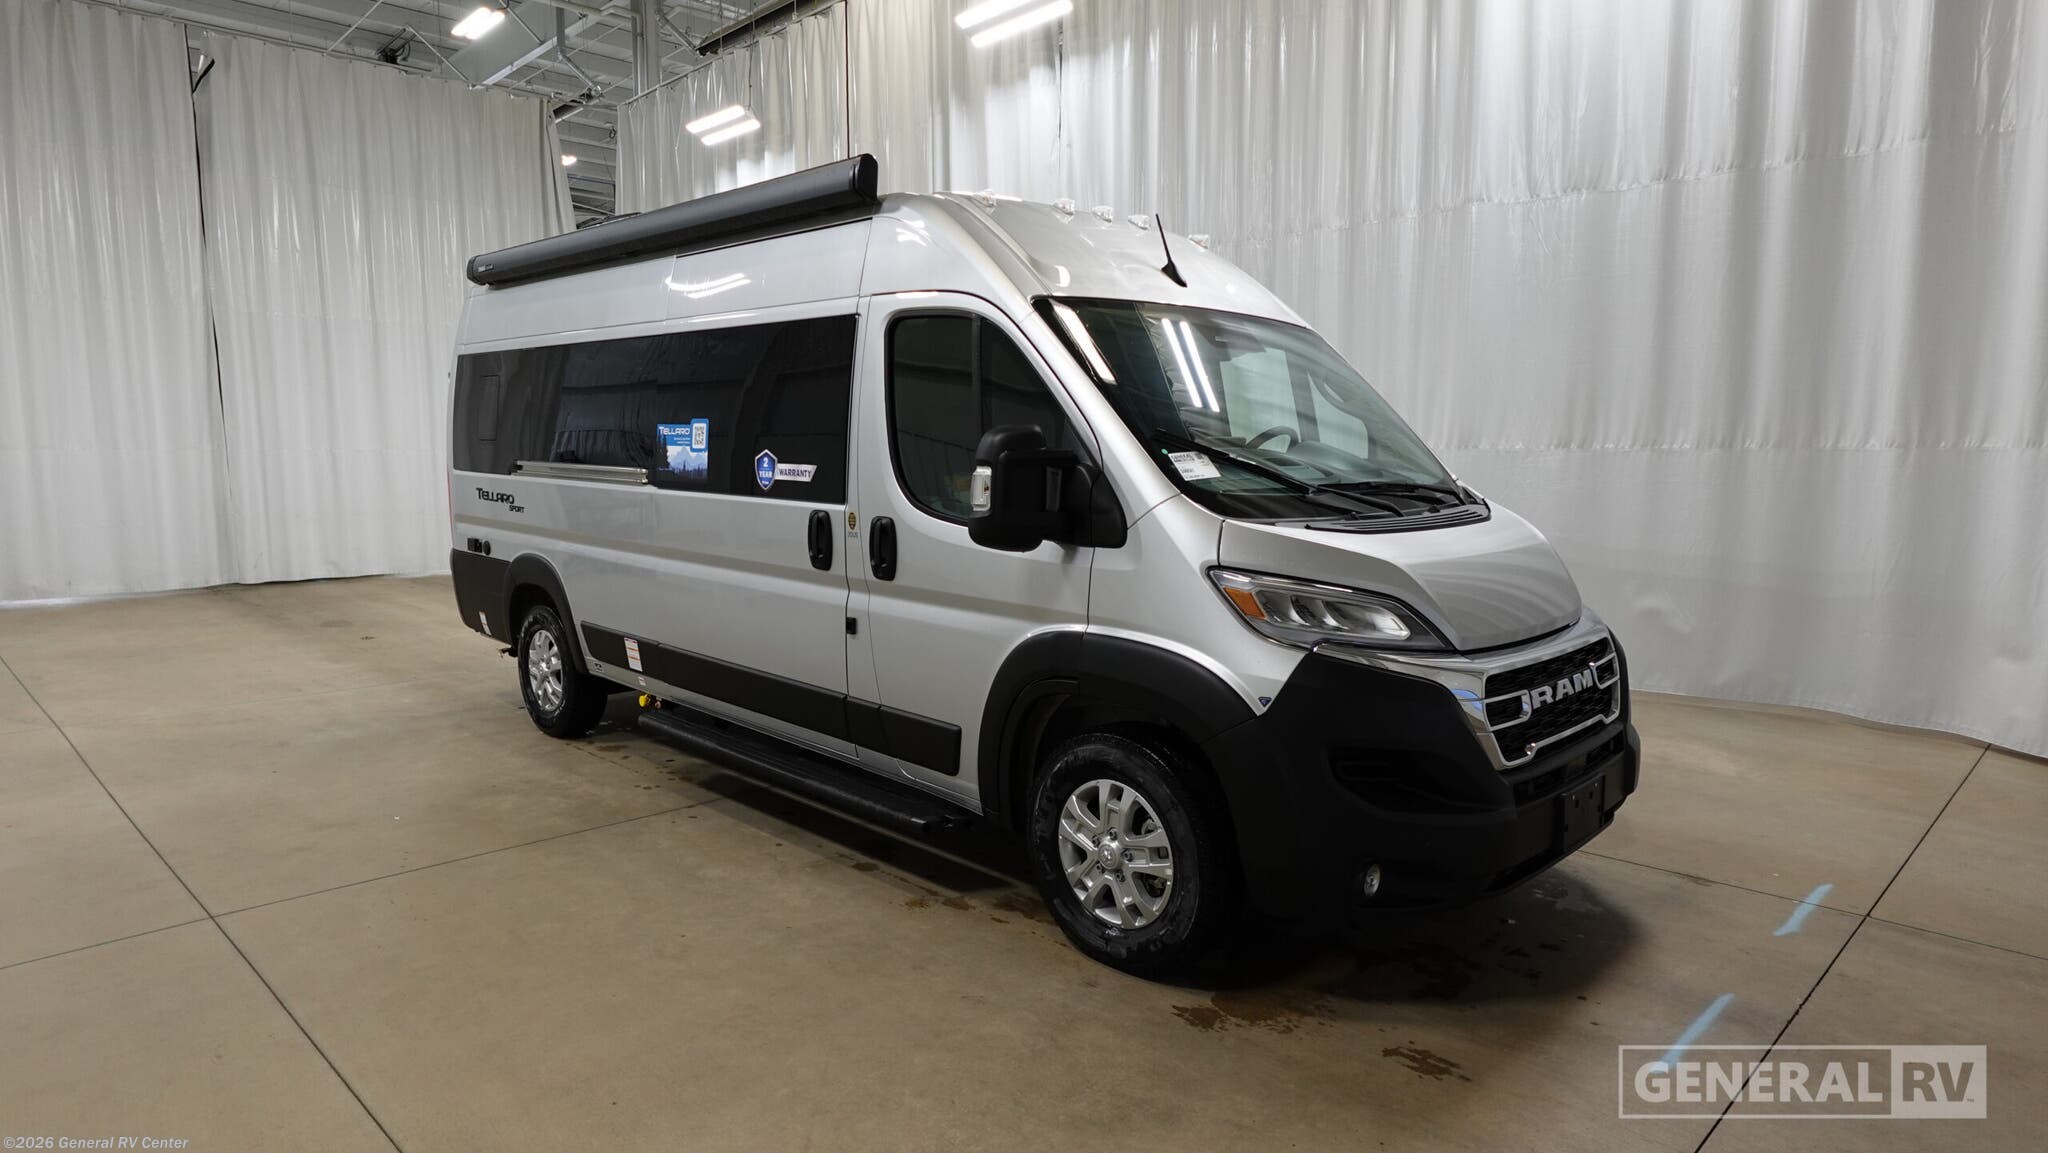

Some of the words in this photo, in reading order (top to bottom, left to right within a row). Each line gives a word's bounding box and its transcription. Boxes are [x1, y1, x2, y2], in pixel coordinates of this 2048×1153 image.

[658, 426, 690, 435] TELLARO
[763, 457, 769, 468] 2
[778, 468, 813, 478] WARRANTY
[475, 487, 515, 505] TELLARO
[509, 504, 525, 513] SPORT
[1530, 668, 1593, 710] RAM
